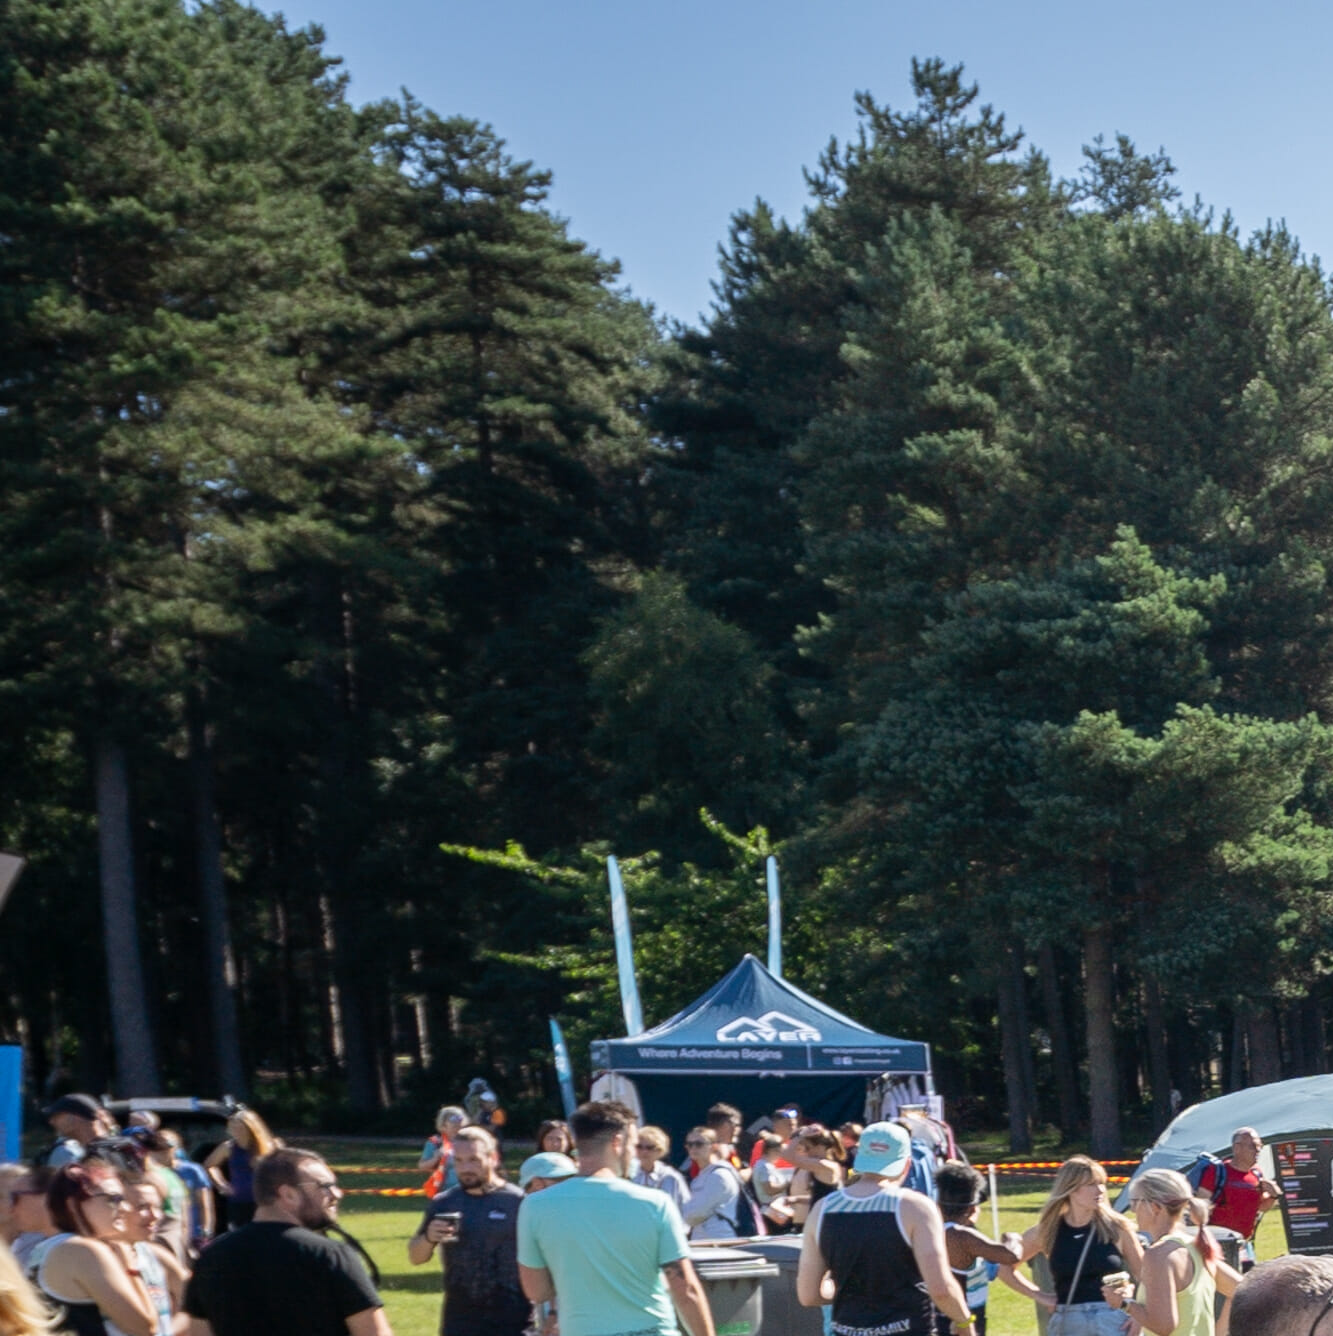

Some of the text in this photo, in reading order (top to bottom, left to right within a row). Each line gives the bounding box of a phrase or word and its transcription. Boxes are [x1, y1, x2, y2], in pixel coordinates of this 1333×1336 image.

[717, 1029, 822, 1043] LAYER
[637, 1047, 783, 1062] Where Adventure Begins
